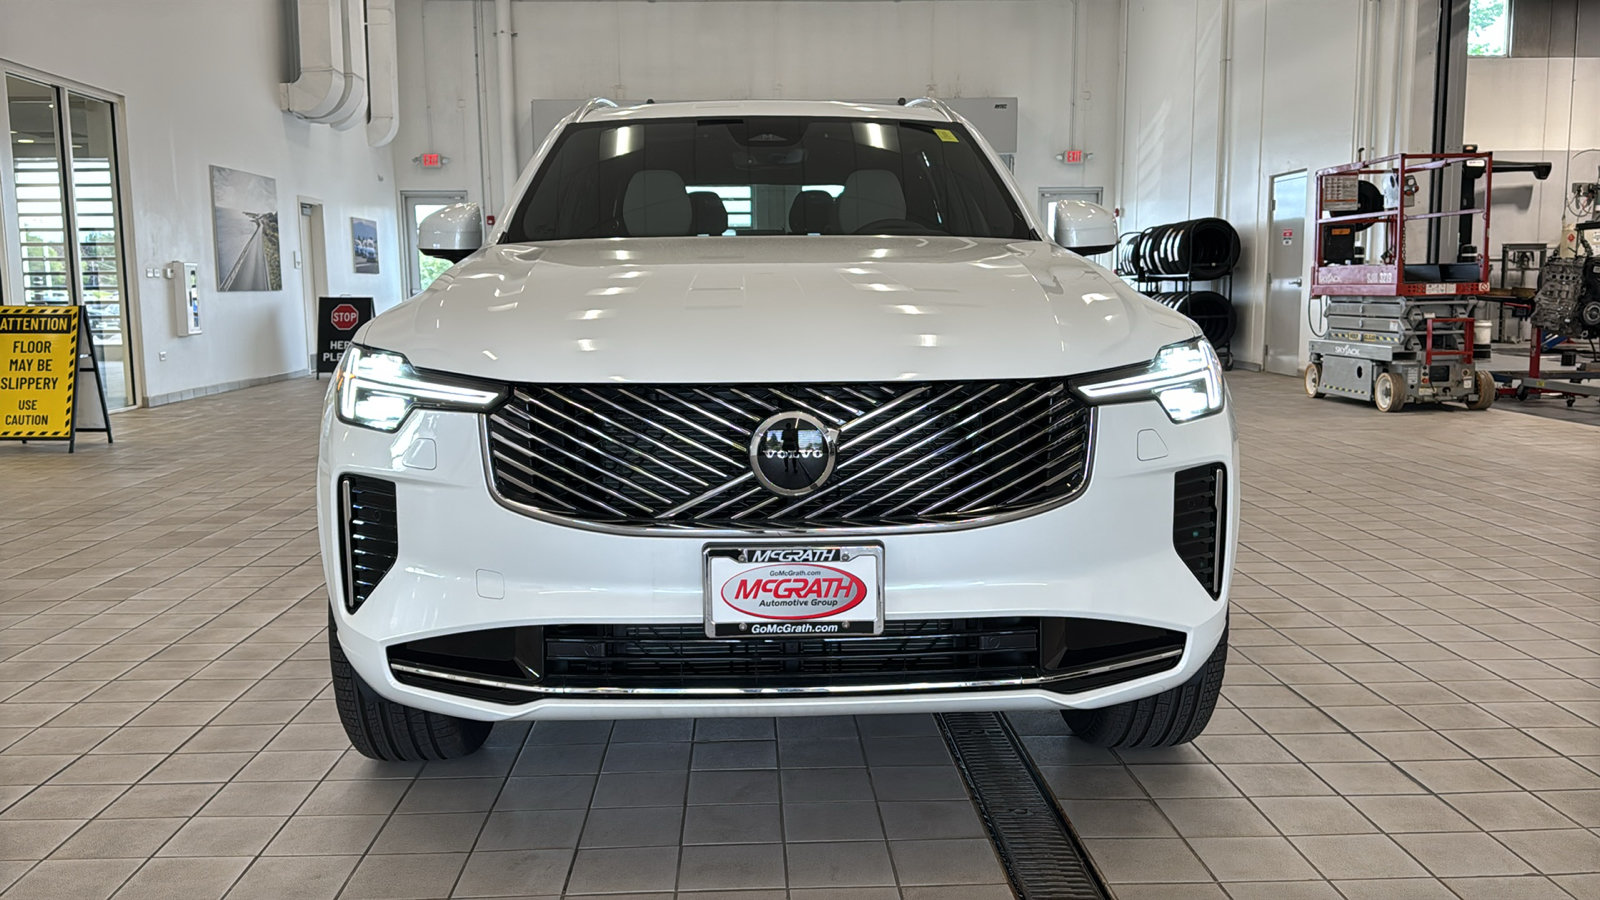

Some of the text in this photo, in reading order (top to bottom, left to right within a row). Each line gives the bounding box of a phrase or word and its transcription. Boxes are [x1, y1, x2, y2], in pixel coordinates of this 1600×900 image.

[423, 153, 439, 166] EXIT
[1067, 150, 1082, 162] EXIT
[333, 312, 357, 322] STOP
[0, 317, 68, 331] ATTENTION
[12, 340, 52, 353] FLOOR
[330, 341, 351, 350] HER
[9, 358, 53, 371] MAY BE
[0, 376, 59, 390] SLIPPERY
[18, 399, 38, 411] USE
[5, 414, 49, 426] CAUTION
[762, 449, 824, 459] VOLVO
[769, 569, 822, 577] GoMcGrath.com
[759, 598, 838, 608] Automotive Group
[751, 623, 838, 634] GoMcGrath.com
